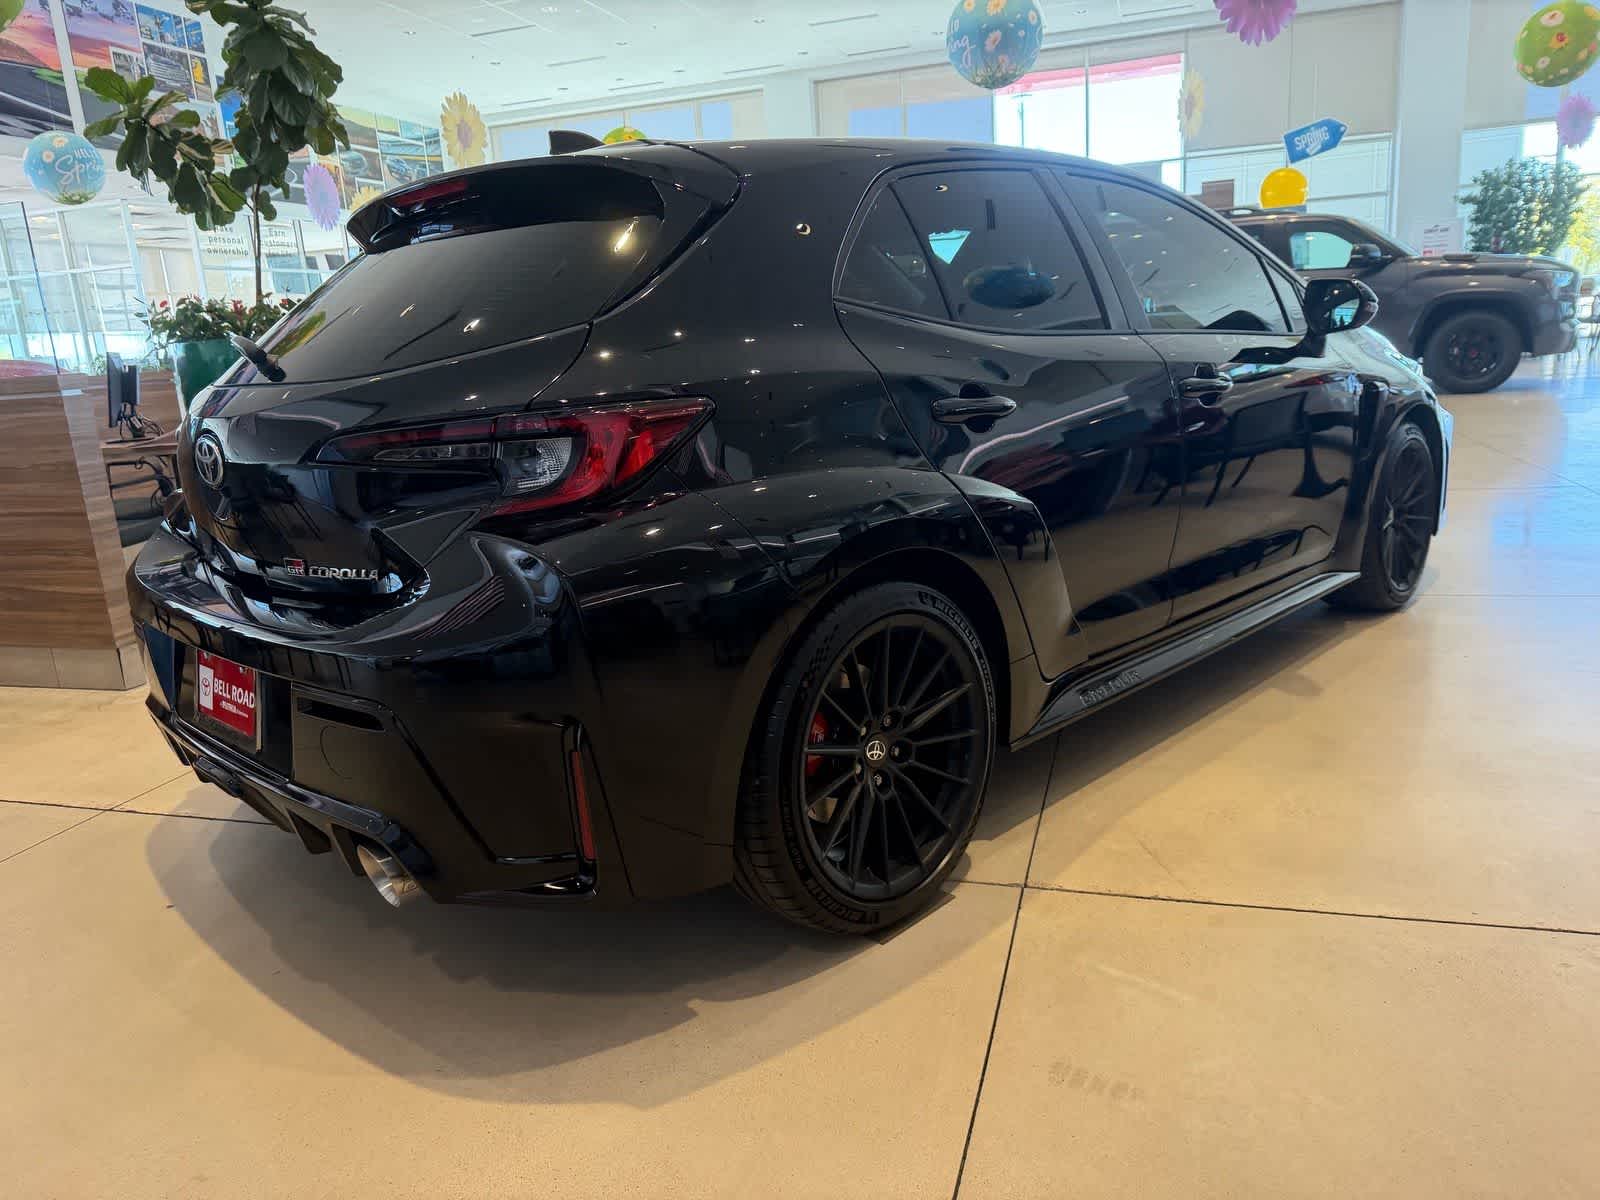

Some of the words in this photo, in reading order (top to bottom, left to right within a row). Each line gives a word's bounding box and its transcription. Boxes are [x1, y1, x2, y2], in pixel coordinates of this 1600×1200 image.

[208, 234, 244, 246] personal
[207, 246, 249, 256] ownership
[309, 566, 379, 580] COROLLA
[213, 677, 231, 699] BELL
[232, 685, 256, 709] ROAD
